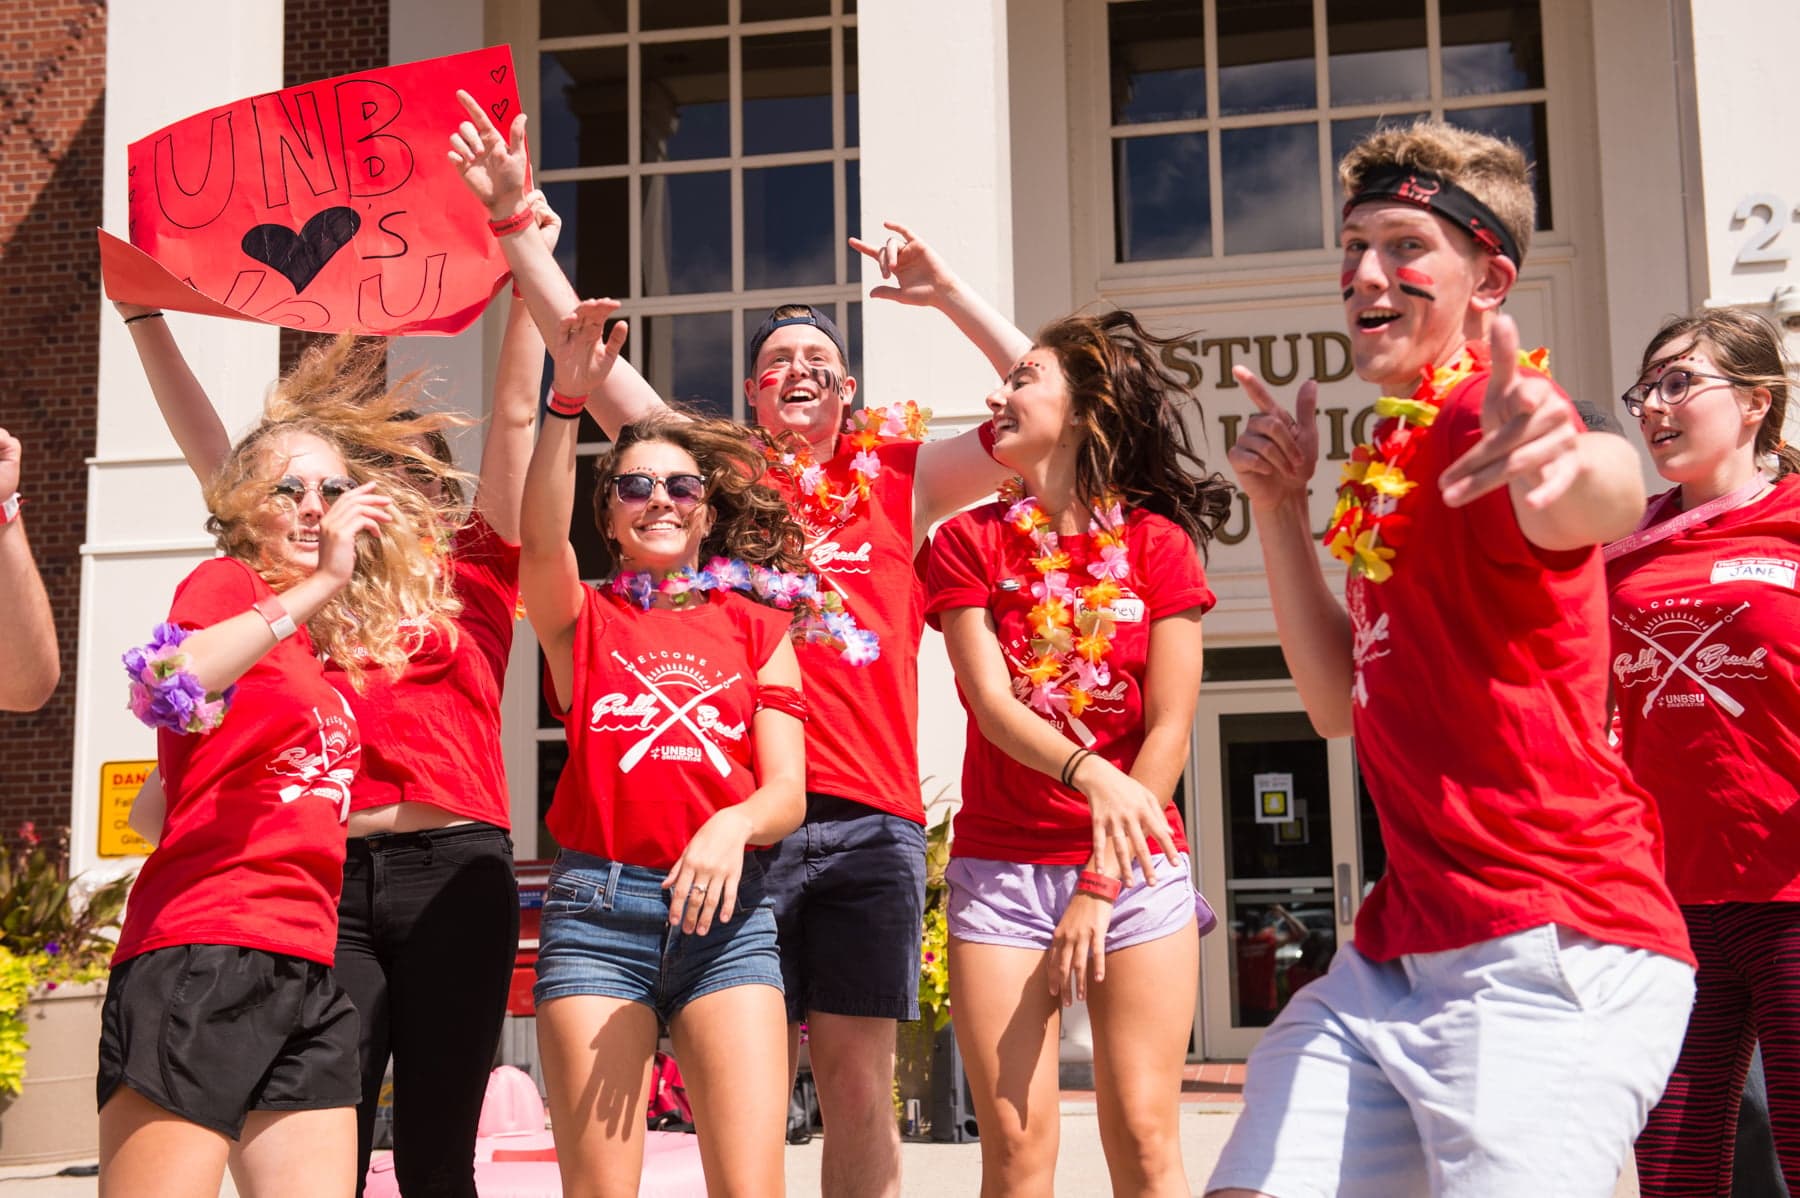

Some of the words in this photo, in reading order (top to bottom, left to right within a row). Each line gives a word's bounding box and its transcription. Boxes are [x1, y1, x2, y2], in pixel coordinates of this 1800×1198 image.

[154, 79, 414, 230] UNB
[1160, 331, 1355, 390] STUD
[1729, 565, 1777, 578] JANE
[624, 649, 708, 673] WELCOME
[1695, 643, 1769, 674] Beach
[1664, 693, 1705, 704] UNBSU
[660, 745, 702, 758] UNBSU
